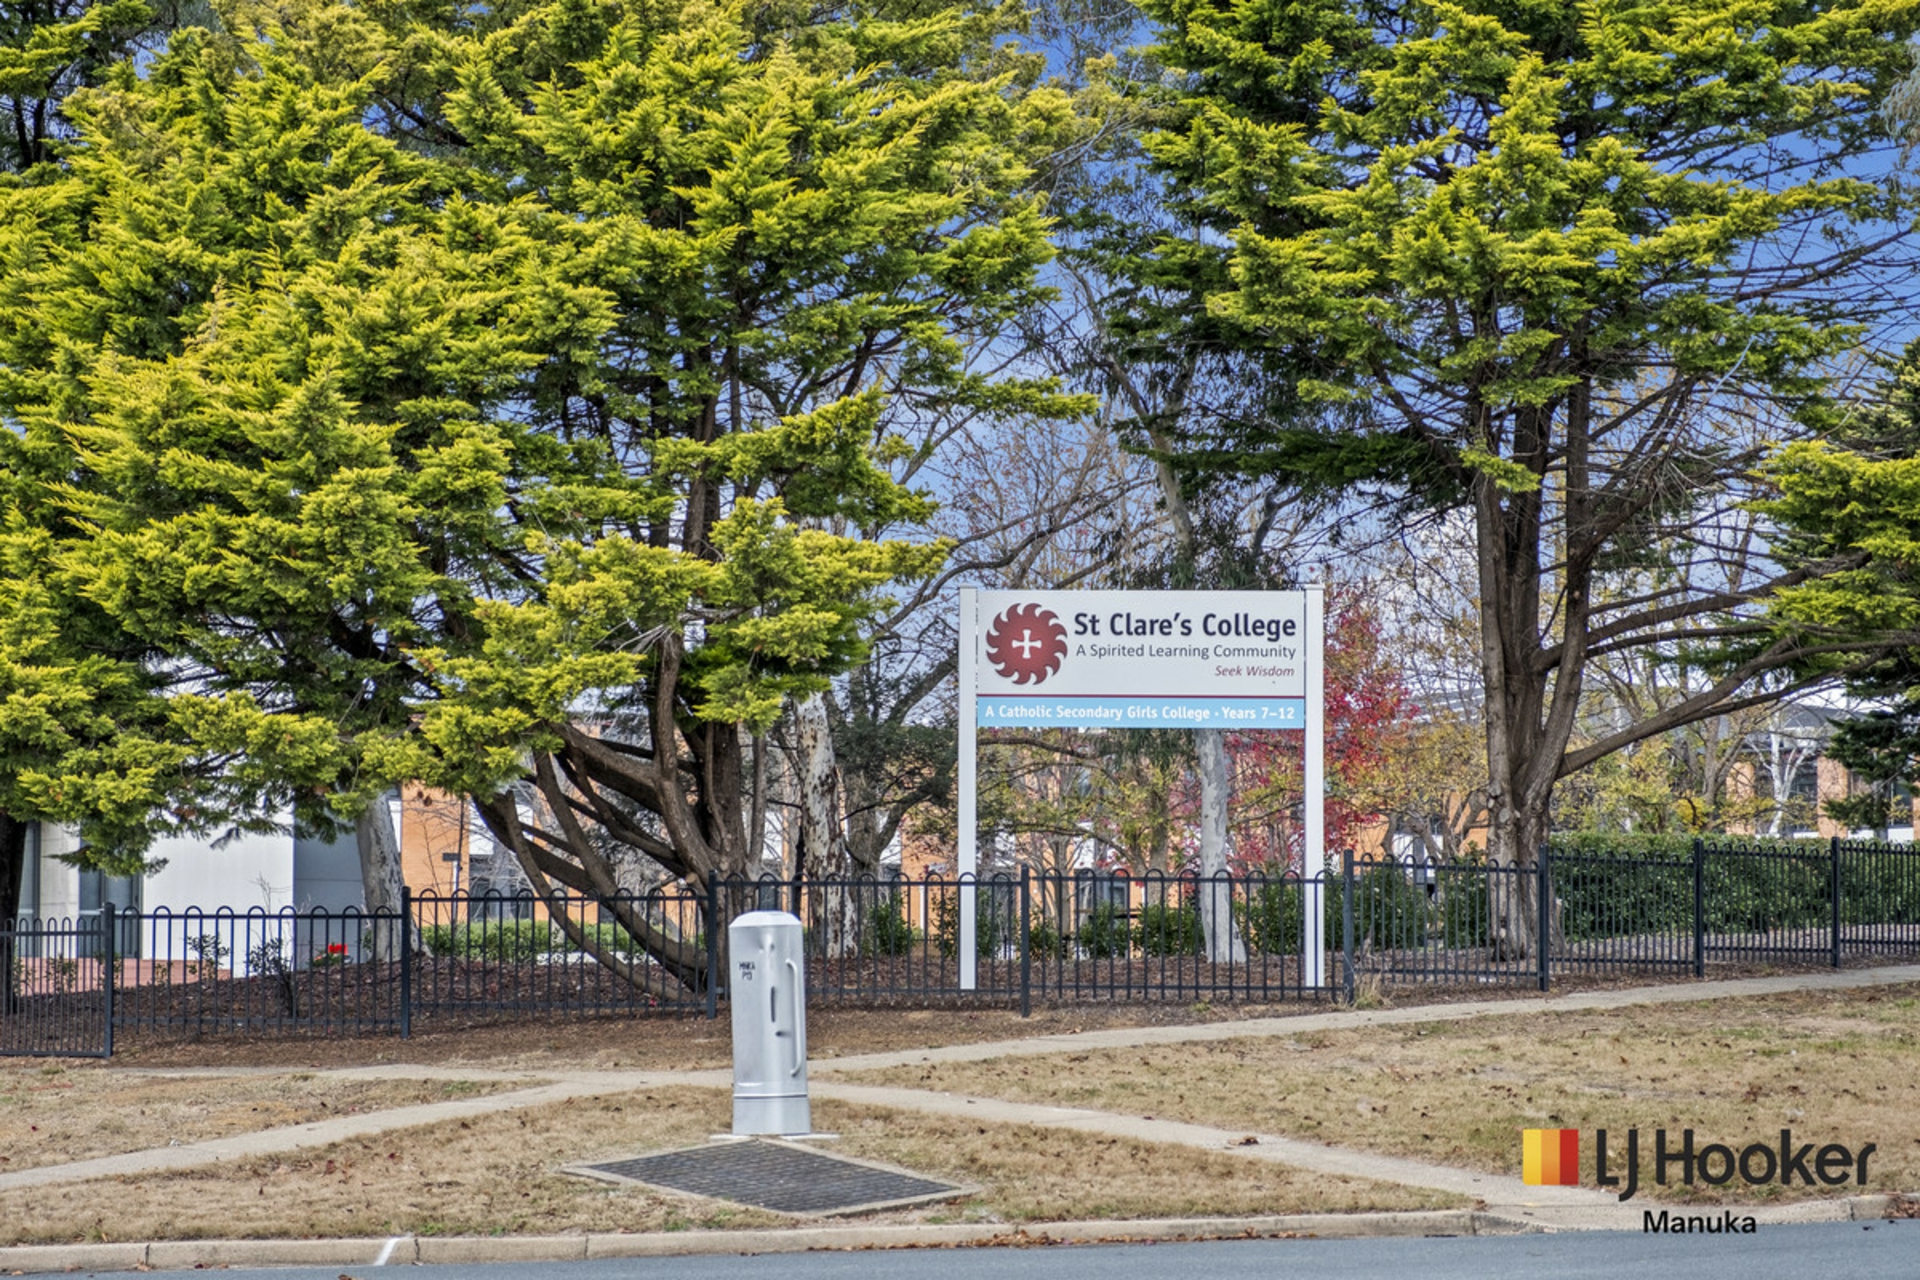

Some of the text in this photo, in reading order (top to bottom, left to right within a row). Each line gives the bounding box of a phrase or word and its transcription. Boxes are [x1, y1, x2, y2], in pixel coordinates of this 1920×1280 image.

[1074, 612, 1100, 636] St
[1203, 613, 1296, 642] College
[1076, 644, 1296, 660] A Spirited Learning Community
[1215, 665, 1295, 677] Seek Wisdom
[985, 705, 994, 718] A
[999, 705, 1052, 718] Catholic
[1056, 706, 1123, 721] Secondary
[1127, 706, 1158, 719] Girls
[1162, 706, 1210, 722] College
[1221, 706, 1256, 719] Years
